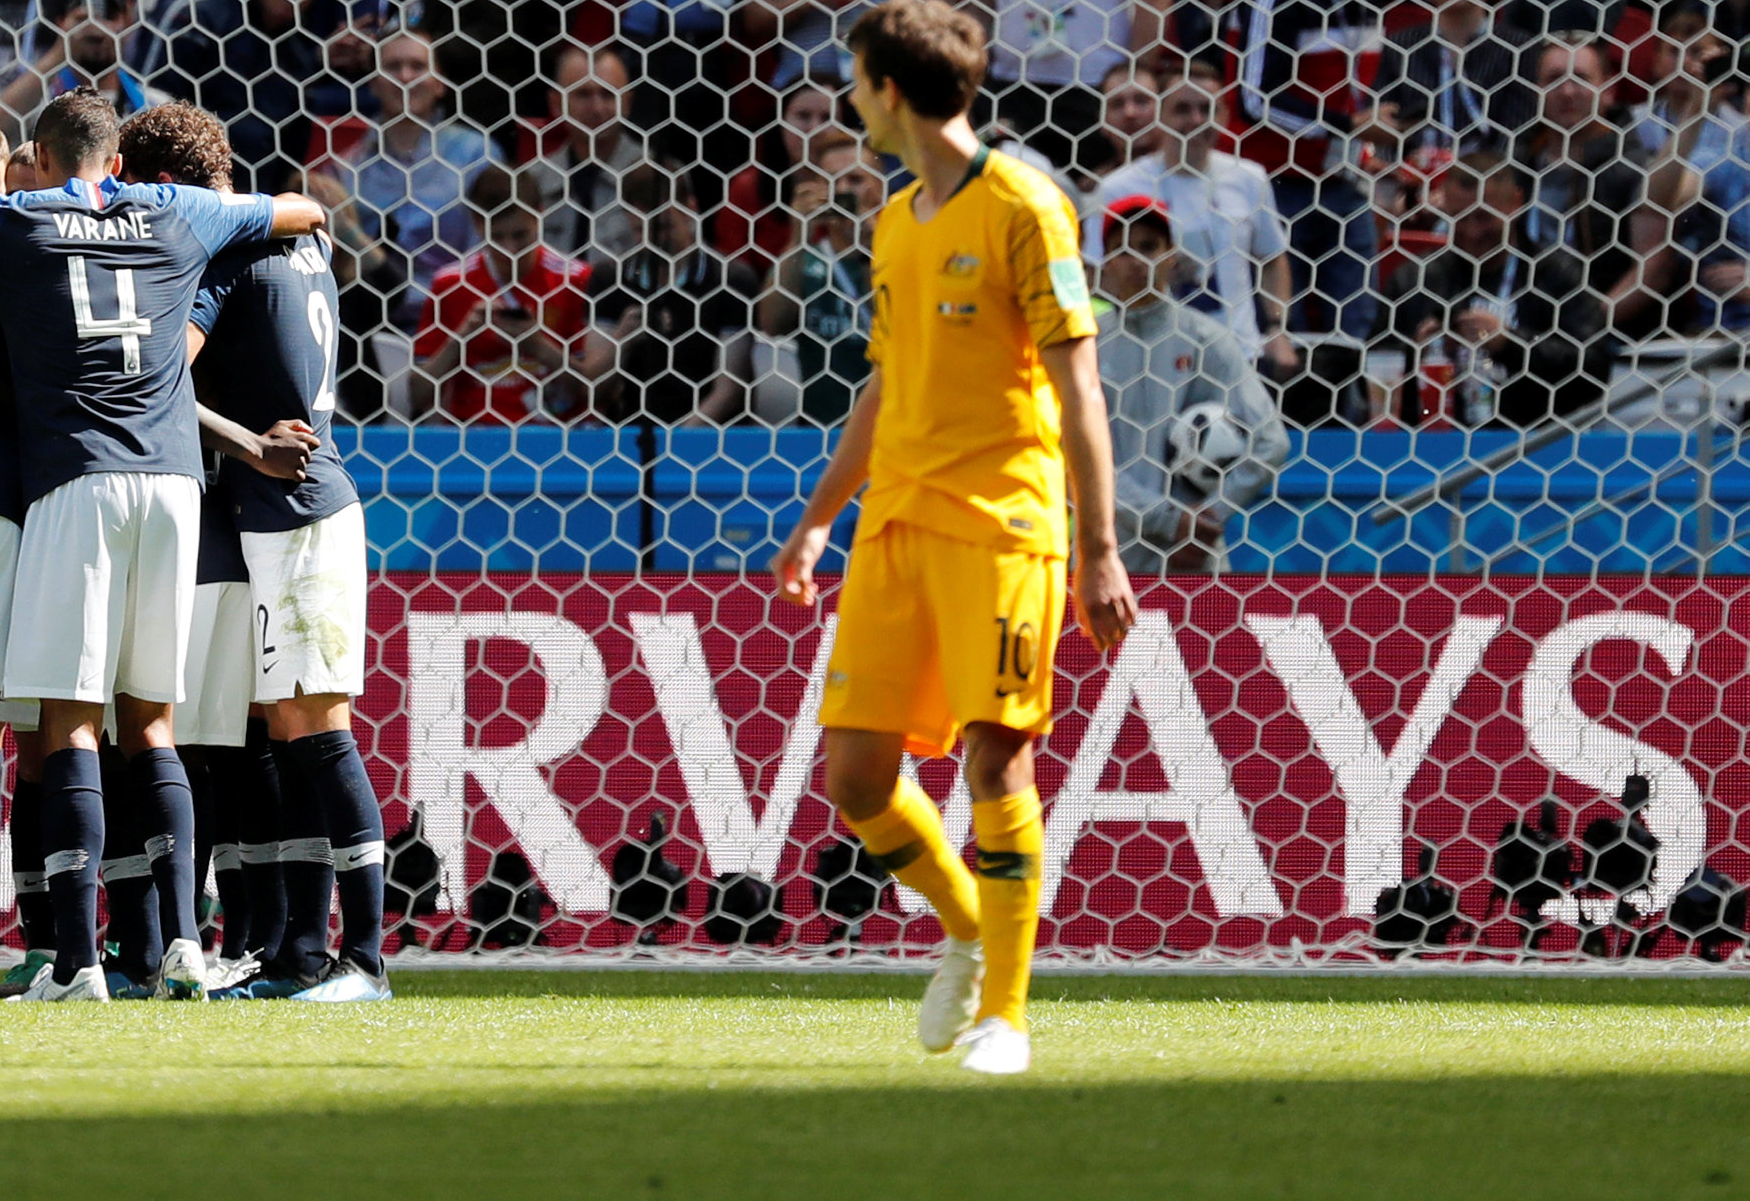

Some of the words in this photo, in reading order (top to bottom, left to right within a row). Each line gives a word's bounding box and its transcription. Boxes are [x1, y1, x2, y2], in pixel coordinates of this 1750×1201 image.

[53, 211, 153, 240] VARANE
[67, 256, 151, 374] 4
[307, 290, 336, 411] 2
[257, 603, 276, 655] 2
[994, 617, 1035, 680] 10
